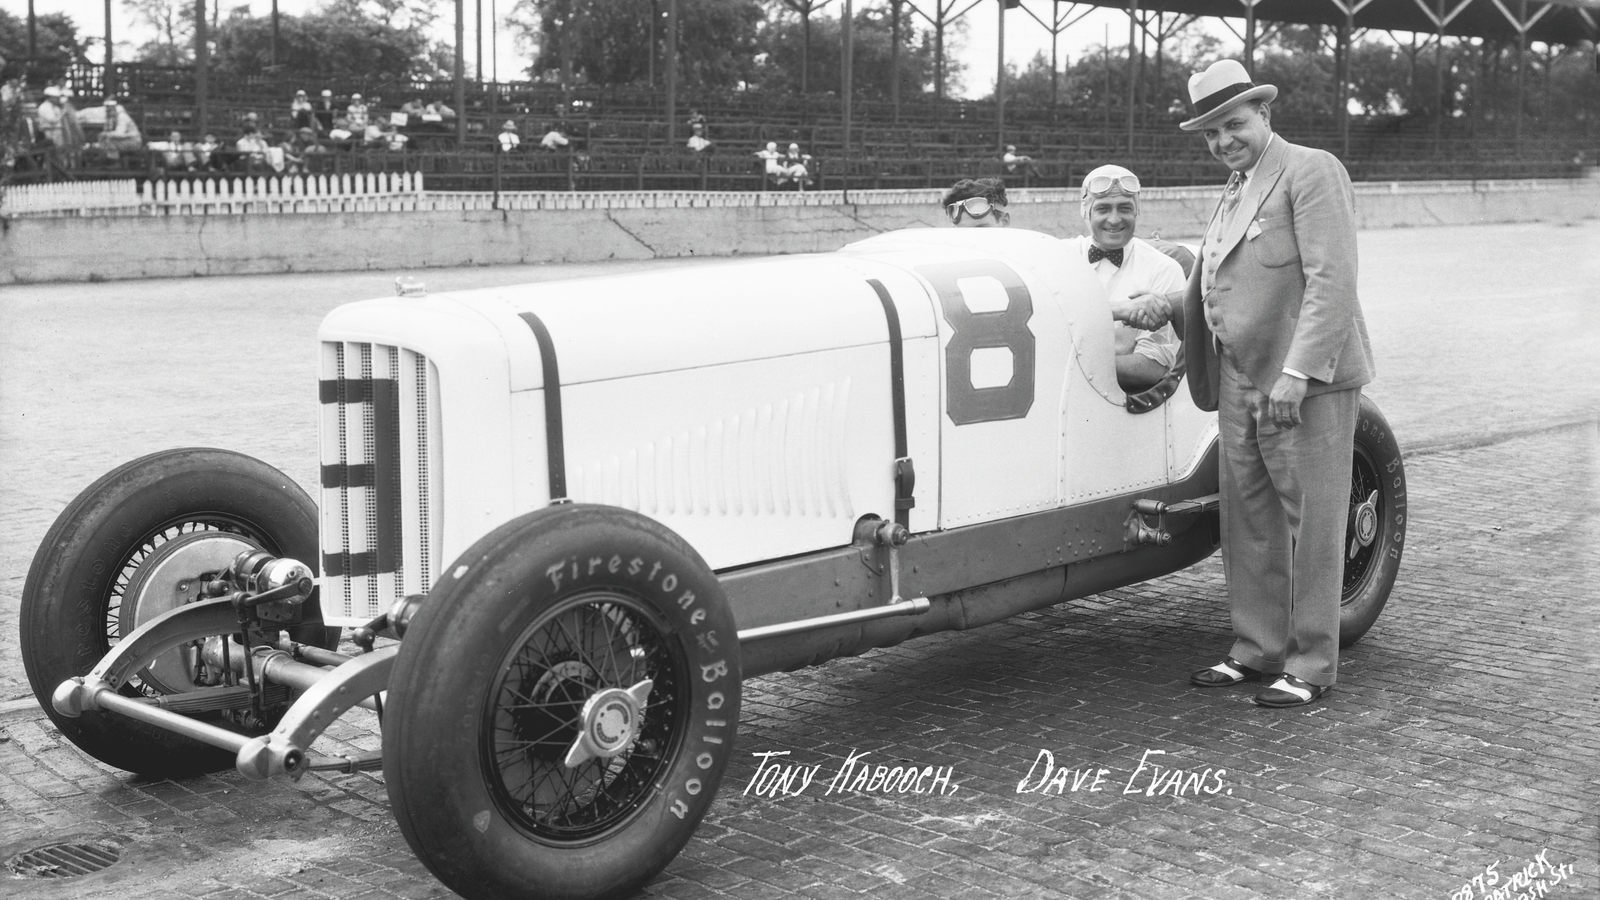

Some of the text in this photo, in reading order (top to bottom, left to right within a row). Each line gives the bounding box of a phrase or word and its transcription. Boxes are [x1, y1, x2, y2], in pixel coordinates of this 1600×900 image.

[913, 259, 1035, 426] 8
[1385, 456, 1406, 560] Balloon
[545, 554, 729, 820] Firestone Balloon
